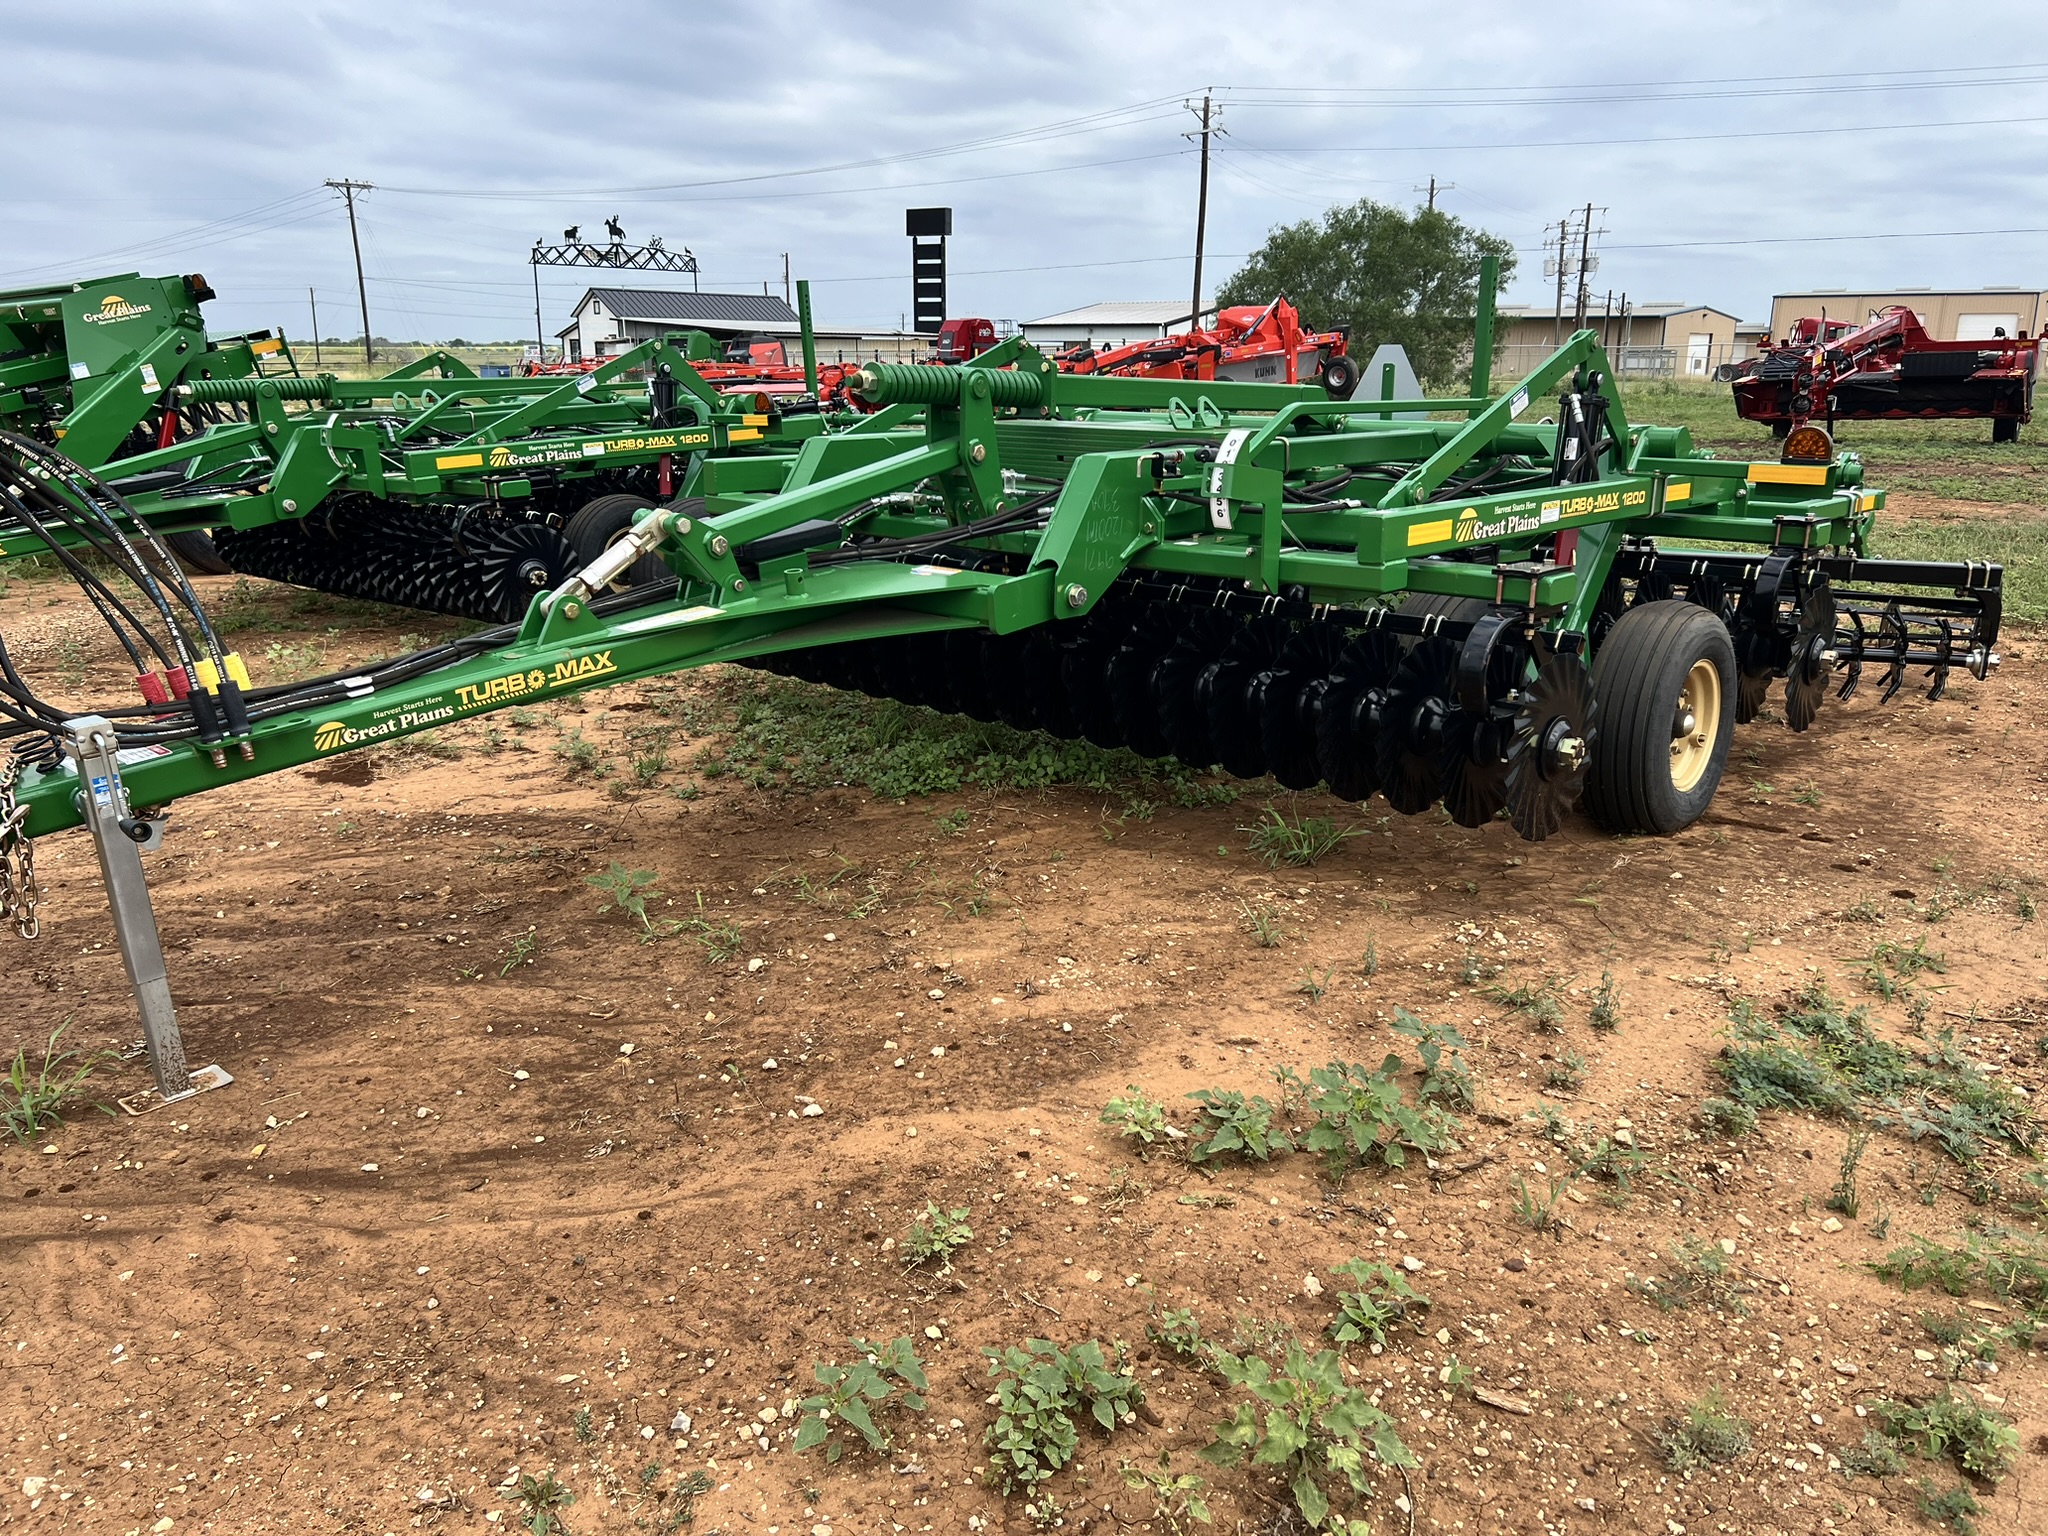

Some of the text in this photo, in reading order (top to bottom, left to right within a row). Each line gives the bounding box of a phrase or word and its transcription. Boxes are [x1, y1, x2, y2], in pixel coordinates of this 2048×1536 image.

[83, 304, 152, 323] Great Plains
[1254, 365, 1277, 379] KUHN
[679, 433, 709, 445] 1200
[14, 443, 40, 461] WINNER
[508, 450, 582, 465] Great Plains
[1622, 490, 1646, 505] 1200
[1494, 506, 1512, 514] Harvest
[1512, 503, 1525, 512] Starts
[1525, 501, 1537, 509] Here
[1473, 514, 1540, 539] Great Plains
[176, 638, 190, 663] WINNER
[455, 650, 614, 705] TURBO-MAX
[373, 696, 443, 719] Harvest Starts Here
[342, 704, 454, 743] Great Plains
